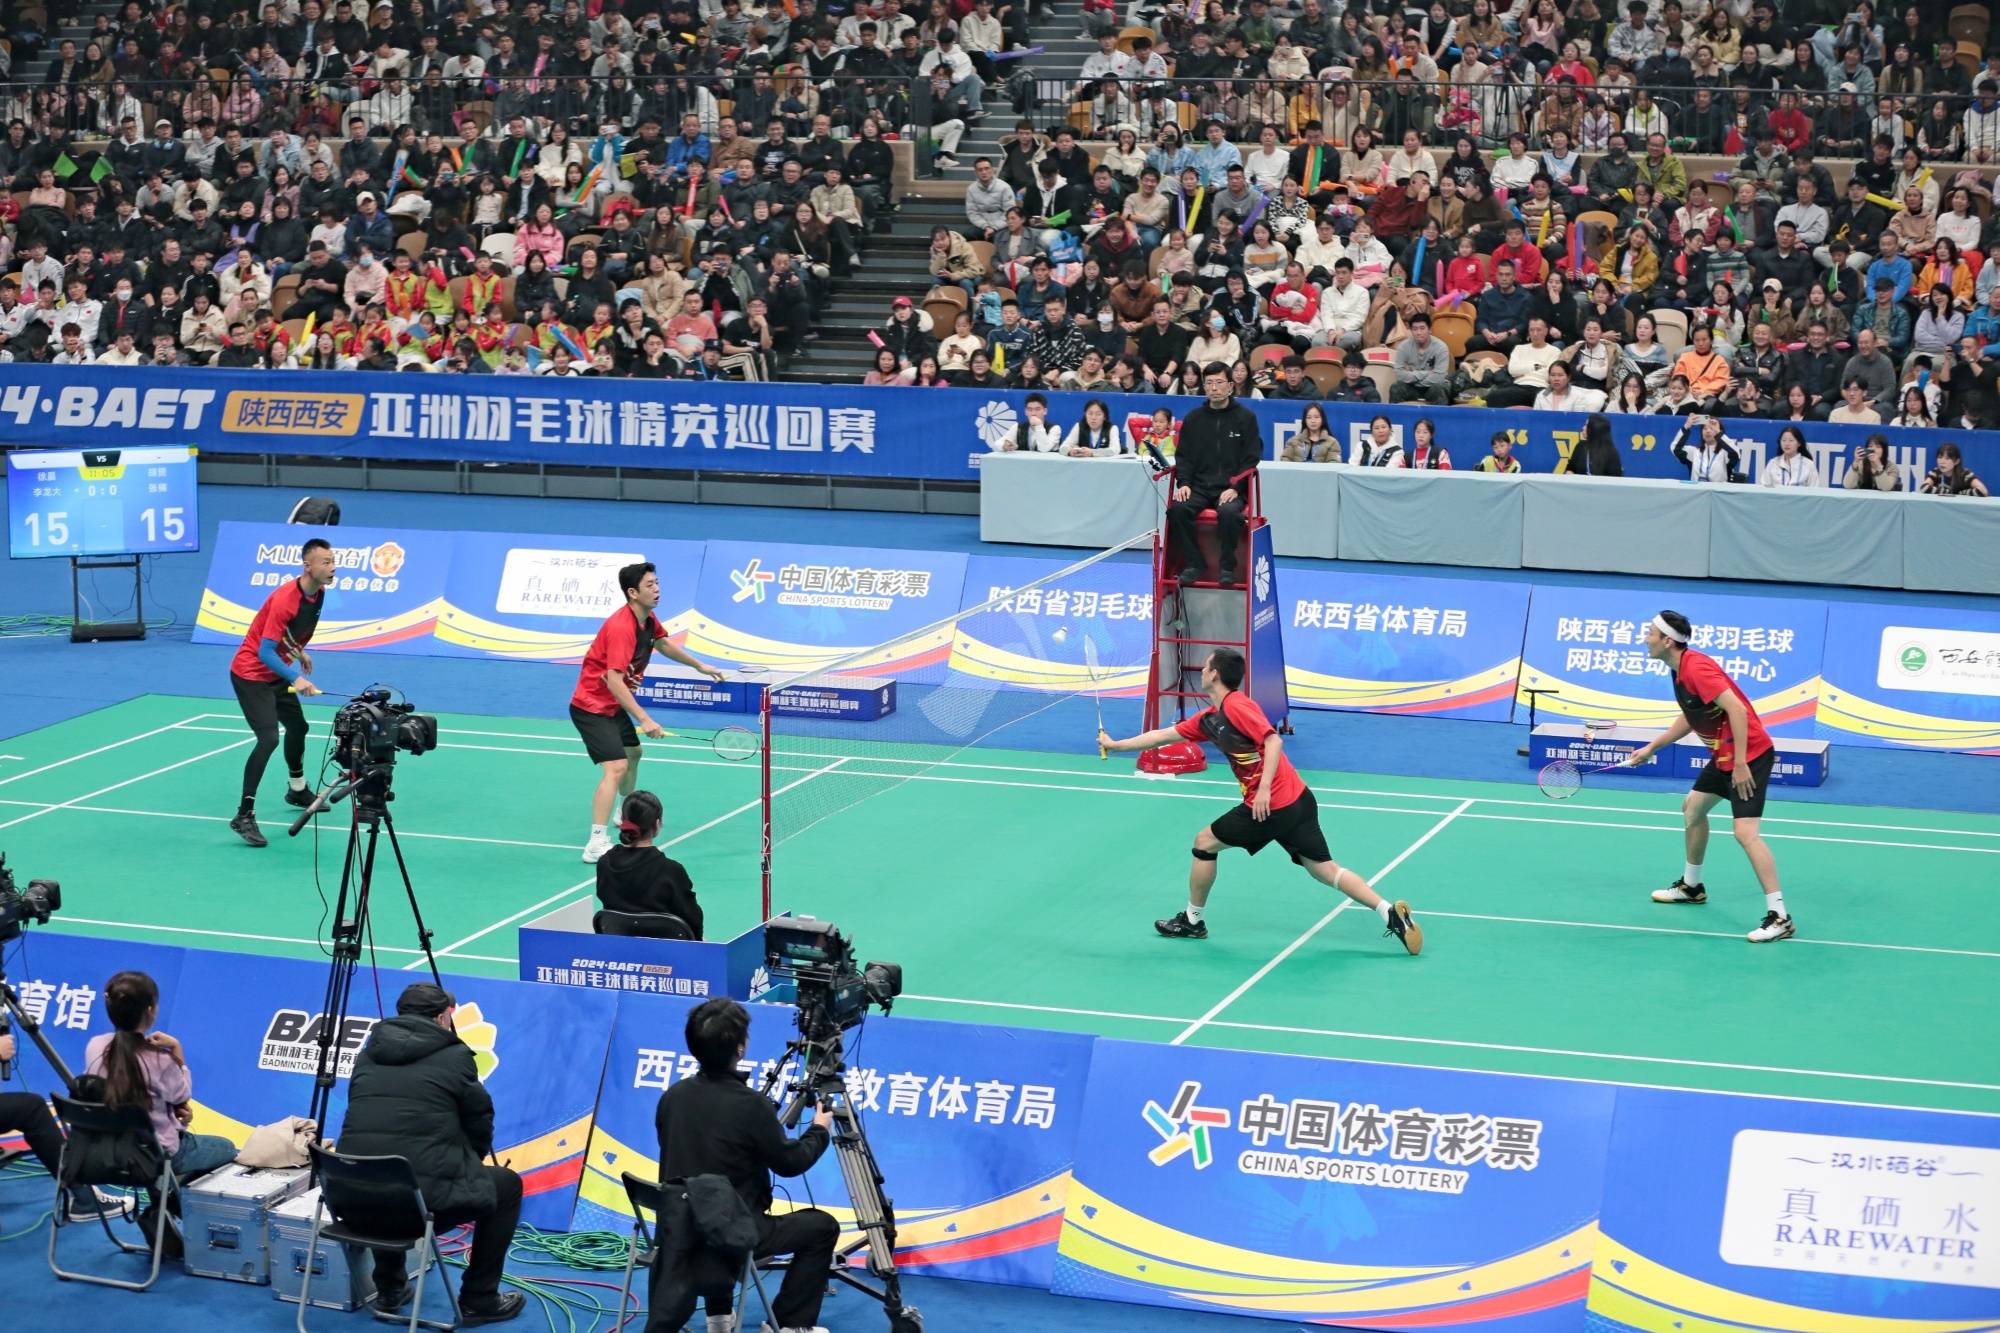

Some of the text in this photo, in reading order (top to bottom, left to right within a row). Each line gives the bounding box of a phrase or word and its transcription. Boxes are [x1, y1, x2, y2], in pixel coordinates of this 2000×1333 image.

[0, 385, 877, 454] 4·BAET 陕西西安 亚洲羽毛球精英巡回赛
[24, 511, 69, 546] 15
[140, 507, 185, 541] 15
[258, 545, 304, 566] MLIL
[781, 566, 929, 596] 中国体育彩票
[521, 592, 613, 606] RAREWATER
[779, 594, 890, 609] CHINA SPORTS LOTTERY
[1294, 599, 1468, 638] 陕西省体育局
[1566, 647, 1777, 683] 网球运动中心
[770, 695, 859, 710] 洲羽毛球精英巡回赛
[536, 966, 709, 997] 亚洲羽毛球精英巡回赛
[571, 958, 643, 972] 2024·BAET
[266, 1012, 375, 1049] BAE
[261, 1059, 315, 1071] BADMINTON
[1242, 1098, 1538, 1166] 中国体育彩票
[1241, 1153, 1465, 1190] CHINA SPORTS LOTTERY
[1776, 1187, 1980, 1235] 真硒水
[1773, 1223, 1977, 1260] RAREWATER
